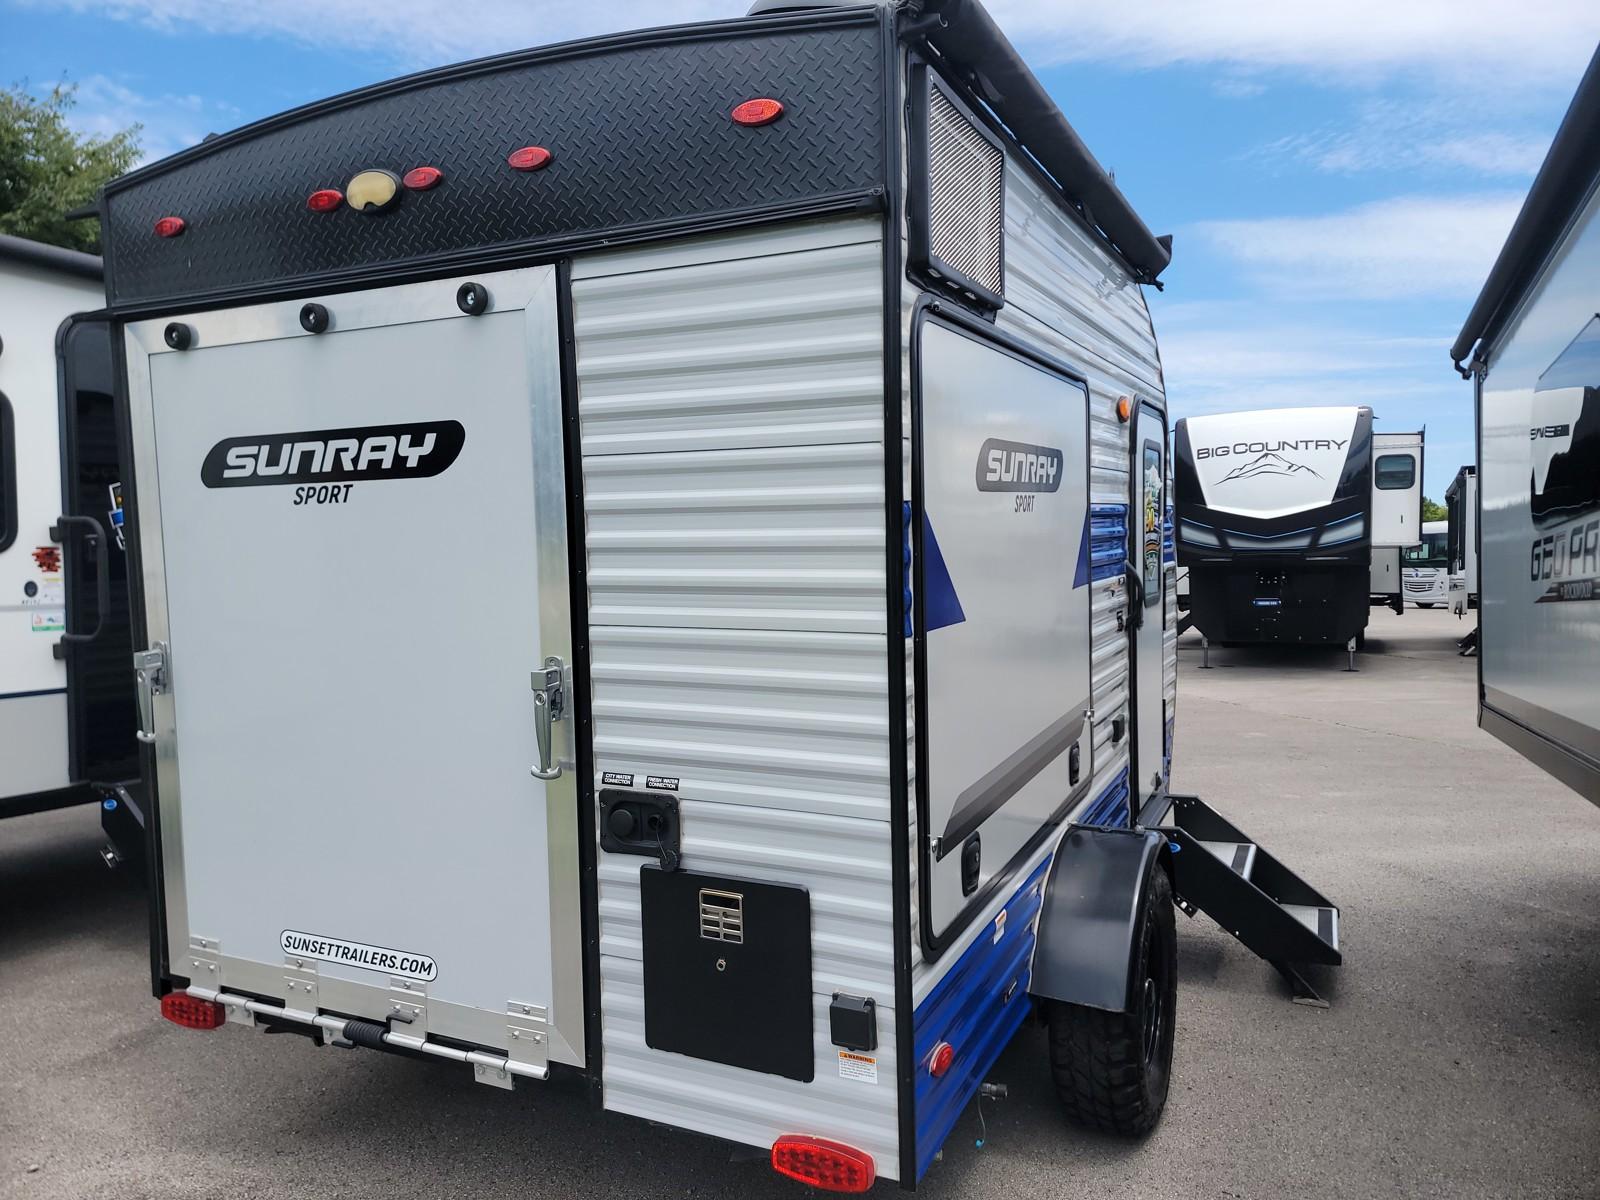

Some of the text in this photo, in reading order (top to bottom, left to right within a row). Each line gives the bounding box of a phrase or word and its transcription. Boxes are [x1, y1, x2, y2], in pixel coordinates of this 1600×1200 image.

[223, 433, 437, 478] SUNRAY
[986, 449, 1058, 484] SUNRAY
[1197, 439, 1348, 460] BIG COUNTRY
[293, 484, 353, 506] SPORT
[1014, 495, 1035, 513] SPORT
[1568, 520, 1600, 577] PR
[284, 935, 433, 976] SUNSETTRAILERS.COM
